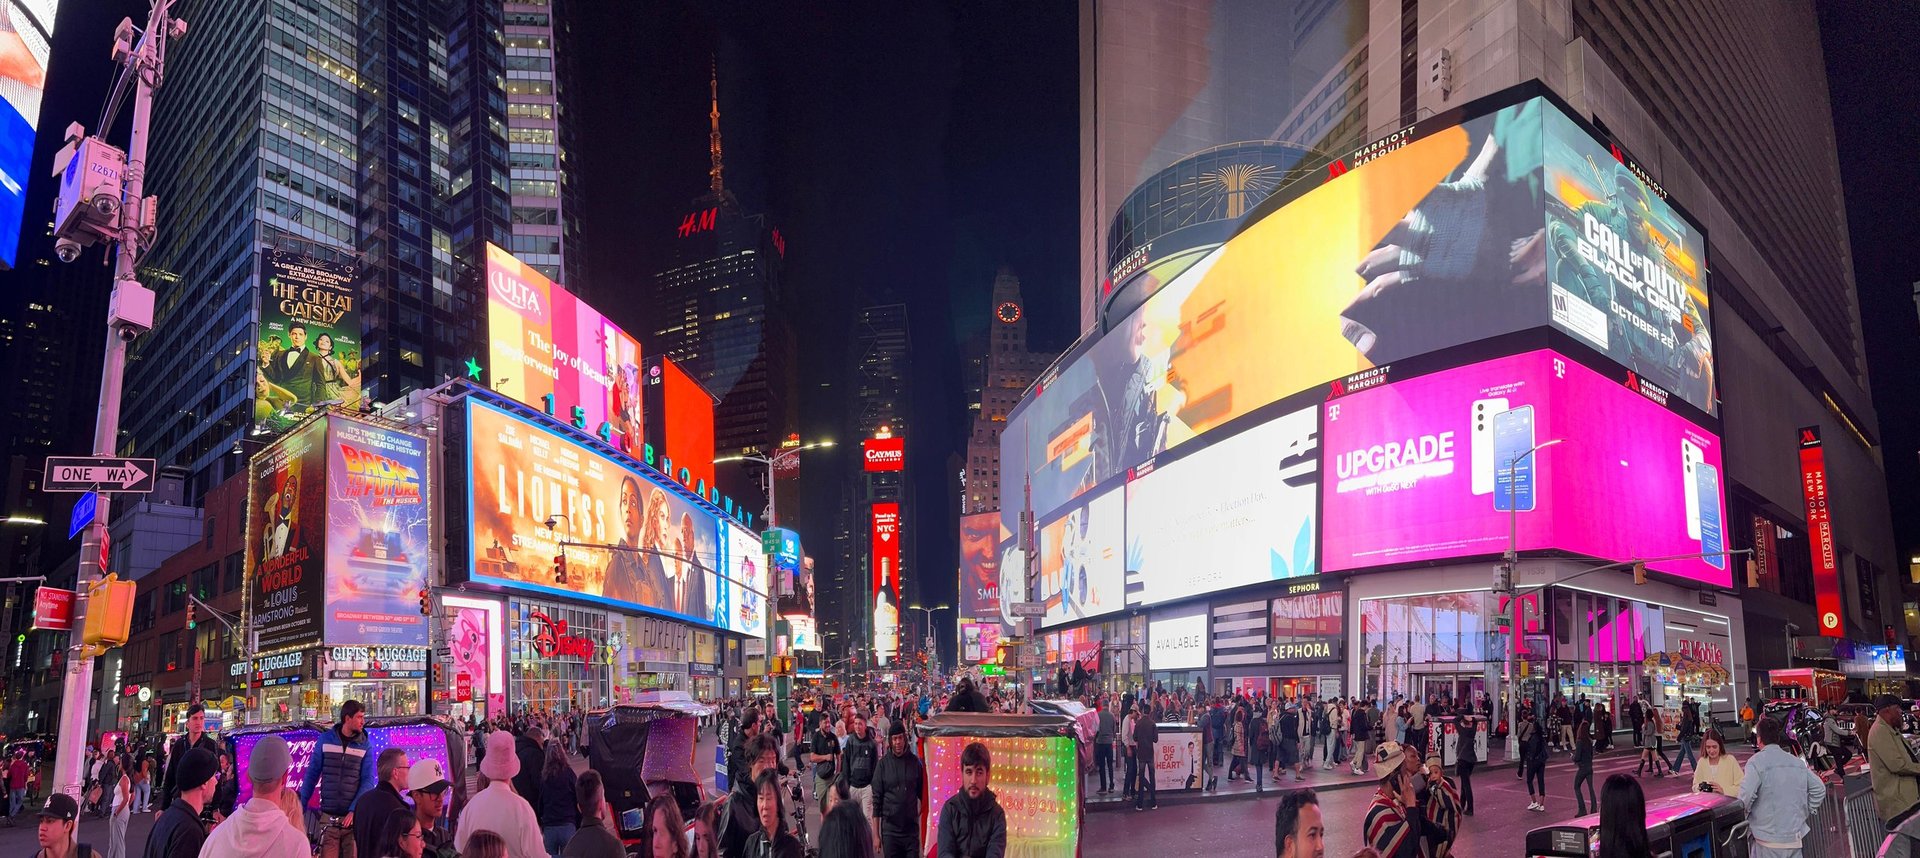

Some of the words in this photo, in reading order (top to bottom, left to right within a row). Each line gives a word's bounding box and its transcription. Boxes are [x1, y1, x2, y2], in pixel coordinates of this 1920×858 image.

[1354, 126, 1415, 160] MARRIOTT
[1354, 139, 1407, 168] MARQUIS
[91, 162, 118, 180] 72671
[1630, 160, 1668, 199] MARRIOTT
[677, 207, 718, 238] H&M
[1113, 243, 1153, 276] MARRIOTT
[1584, 212, 1634, 275] CALL
[1631, 251, 1643, 269] OF
[1643, 254, 1687, 310] DUTY
[289, 270, 339, 286] EXTRAVAGANZA
[303, 267, 316, 275] BIG
[316, 270, 352, 283] BROADWAY
[1113, 256, 1147, 286] MARQUIS
[499, 271, 540, 312] ULTA
[1577, 236, 1645, 298] BLACK
[1646, 284, 1682, 324] OPS
[1682, 313, 1694, 335] 6
[272, 281, 299, 301] THE
[302, 287, 354, 312] GREAT
[1554, 293, 1567, 315] M
[280, 299, 345, 324] GATSBY
[1611, 300, 1660, 341] OCTOBER
[310, 319, 334, 328] MUSICAL
[528, 329, 551, 354] The
[552, 343, 569, 366] Joy
[570, 354, 581, 371] of
[582, 360, 616, 392] Beauty
[651, 376, 661, 386] LG
[1348, 365, 1391, 384] MARRIOTT
[1348, 375, 1386, 391] MARQUIS
[1641, 378, 1669, 399] MARRIOTT
[1641, 387, 1667, 405] MARQUIS
[336, 430, 367, 444] MUSICAL
[367, 438, 396, 451] THEATER
[396, 445, 422, 457] HISTORY
[347, 426, 360, 434] IT'S
[361, 429, 377, 439] TIME
[377, 433, 386, 441] TO
[386, 435, 413, 448] CHANGE
[338, 442, 419, 481] BACK
[865, 449, 902, 459] CAYMUS
[1336, 431, 1455, 479] UPGRADE
[61, 468, 93, 481] ONE
[107, 469, 138, 481] WAY
[260, 465, 275, 479] LOUIS
[1805, 472, 1814, 493] NEW
[364, 475, 420, 497] FUTURE
[643, 442, 753, 528] BROADWAY
[498, 463, 606, 542] LIONESS
[1808, 495, 1817, 520] YORK
[876, 524, 895, 533] NYC
[1815, 471, 1827, 520] MARRIOTT
[1821, 523, 1833, 569] MARQUIS
[535, 525, 552, 540] NEW
[511, 534, 557, 556] STREAMING
[257, 564, 263, 576] A
[262, 545, 310, 574] WONDERFUL
[1526, 567, 1546, 575] 1535
[262, 565, 303, 593] WORLD
[1289, 582, 1320, 594] SEPHORA
[39, 601, 59, 610] Anytime
[40, 592, 47, 600] NO
[48, 592, 70, 601] STANDING
[271, 585, 298, 608] LOUIS
[253, 605, 295, 625] ARMSTRONG
[1827, 616, 1834, 626] P
[643, 617, 688, 651] FOREVER
[1156, 635, 1200, 651] AVAILABLE
[258, 652, 302, 672] LUGGAGE
[332, 647, 368, 661] GIFTS
[376, 648, 427, 661] LUGGAGE
[1272, 643, 1331, 660] SEPHORA
[264, 678, 277, 686] SONY
[1162, 746, 1175, 754] BIG
[1163, 754, 1174, 762] OF
[1156, 761, 1181, 770] HEART
